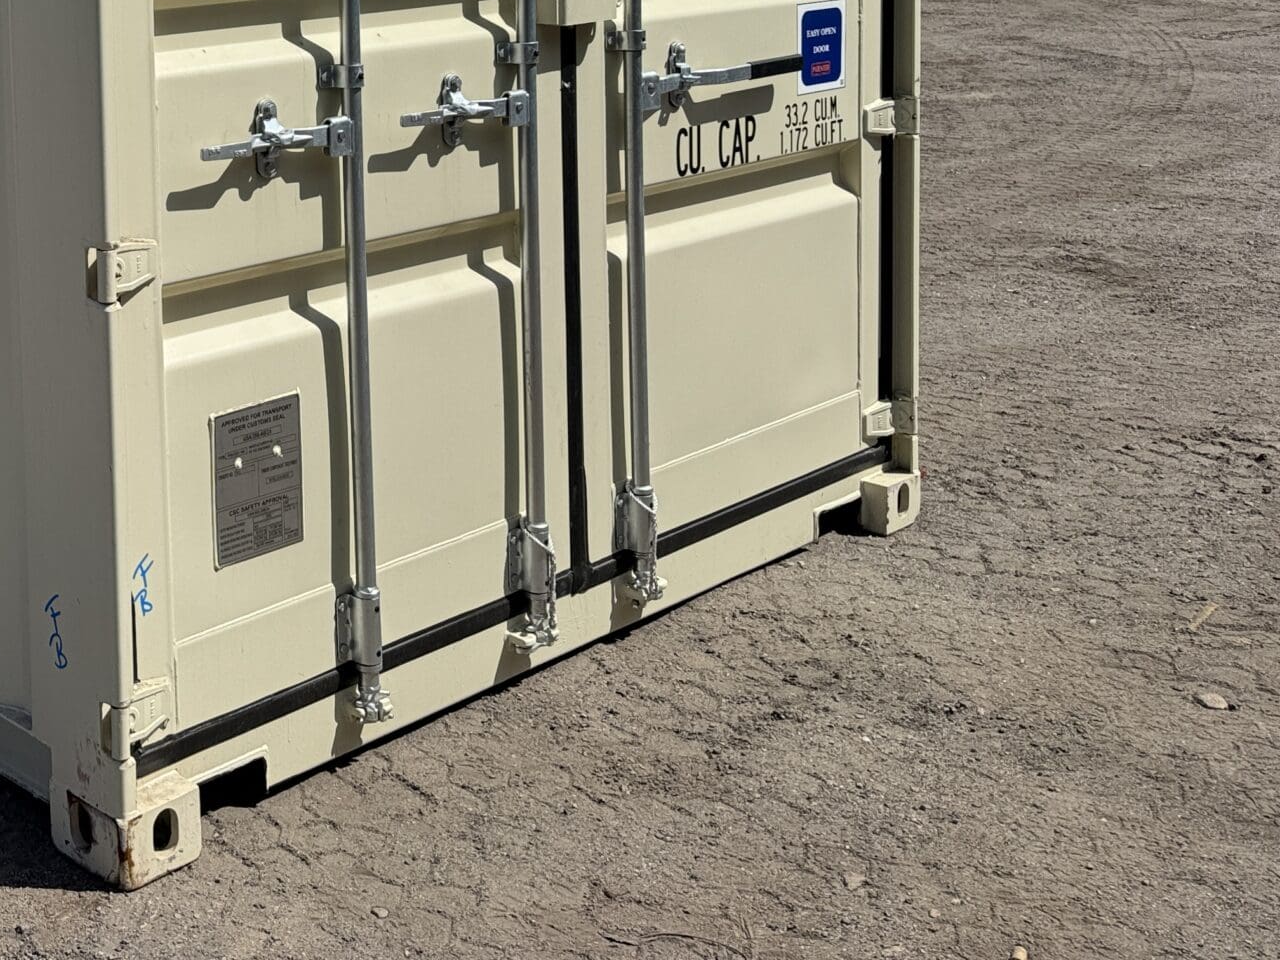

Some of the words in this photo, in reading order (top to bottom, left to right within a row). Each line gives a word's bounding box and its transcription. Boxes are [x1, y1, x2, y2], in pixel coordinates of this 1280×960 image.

[806, 28, 820, 38] EASY
[820, 26, 837, 36] OPEN
[812, 44, 830, 54] DOOR
[785, 102, 808, 129] 33.2
[676, 124, 705, 177] CU.
[718, 115, 760, 168] CAP.
